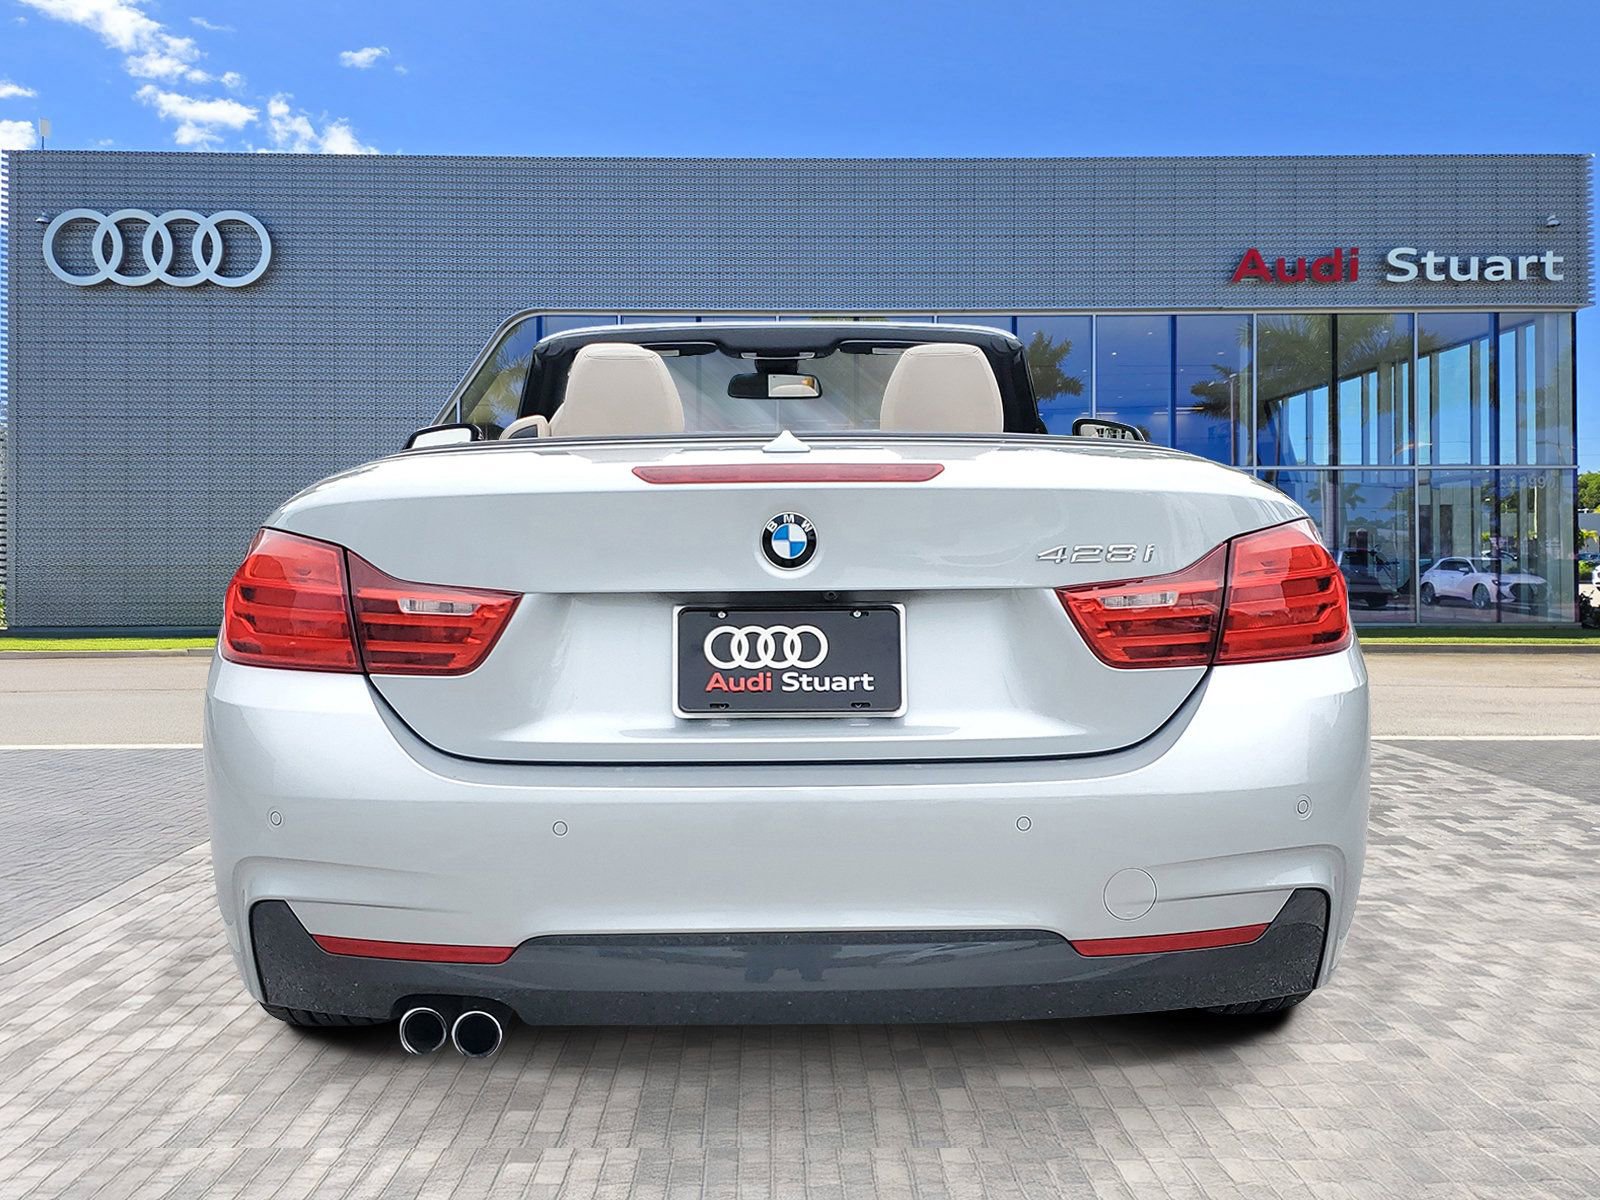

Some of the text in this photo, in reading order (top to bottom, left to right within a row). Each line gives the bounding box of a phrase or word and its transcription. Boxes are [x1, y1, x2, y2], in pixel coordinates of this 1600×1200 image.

[1232, 247, 1564, 283] Audi Stuart
[766, 514, 813, 533] BMW
[1037, 543, 1155, 564] 428i
[705, 671, 875, 693] Audi Stuart
